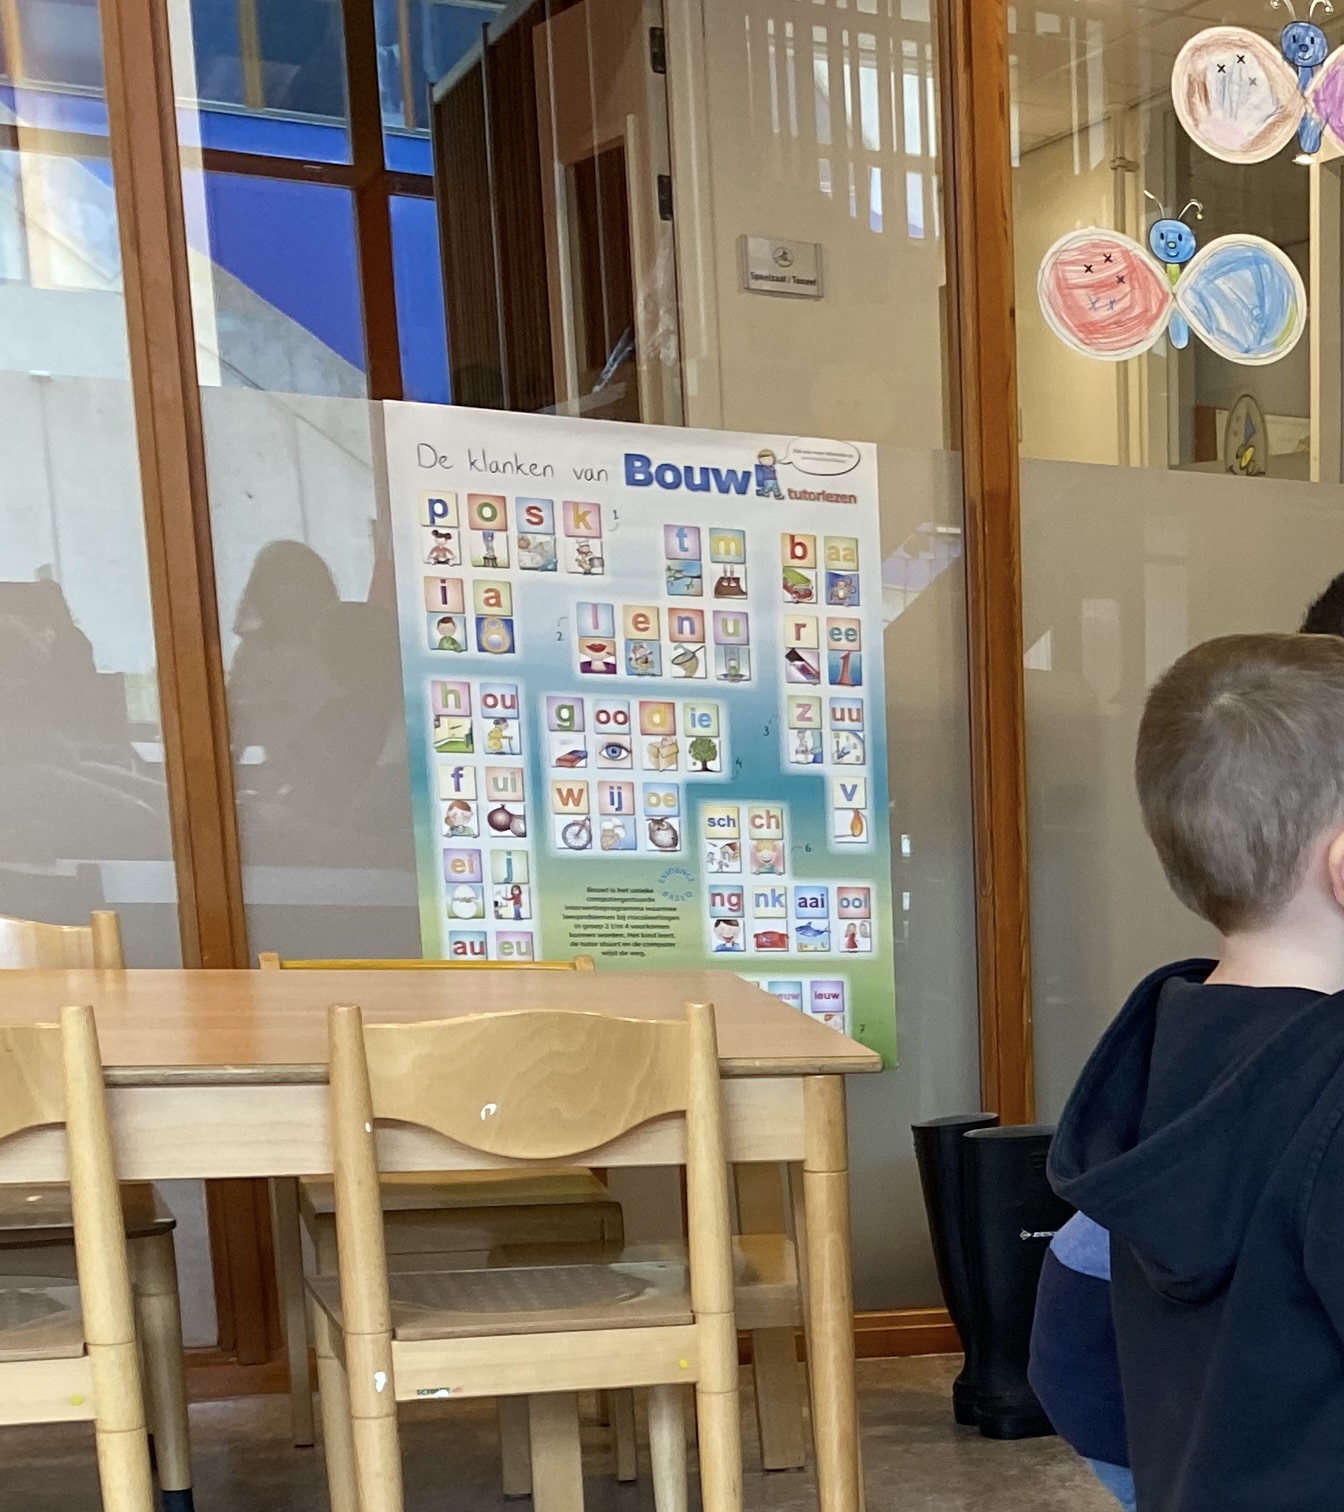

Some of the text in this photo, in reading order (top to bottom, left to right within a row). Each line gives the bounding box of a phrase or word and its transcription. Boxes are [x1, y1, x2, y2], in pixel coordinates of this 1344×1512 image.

[417, 443, 454, 469] De
[467, 448, 554, 477] klanken
[572, 467, 609, 482] van
[787, 488, 858, 504] tutorlezen
[427, 498, 592, 530] p o s k
[676, 527, 741, 557] t m
[789, 535, 856, 563] b aa
[440, 578, 503, 608] i a
[631, 612, 650, 632] e
[677, 616, 696, 636] n
[721, 617, 740, 638] u
[794, 622, 857, 643] r ee
[441, 681, 516, 710] h ou
[555, 703, 712, 731] g oo d ie
[796, 703, 861, 723] z uu
[450, 766, 517, 793] f ui
[839, 783, 858, 802] v
[556, 785, 677, 812] w ij oe
[707, 809, 780, 830] sch ch
[450, 851, 513, 884] ei j
[711, 888, 868, 913] ng nk aai ooi
[453, 939, 531, 956] au eu
